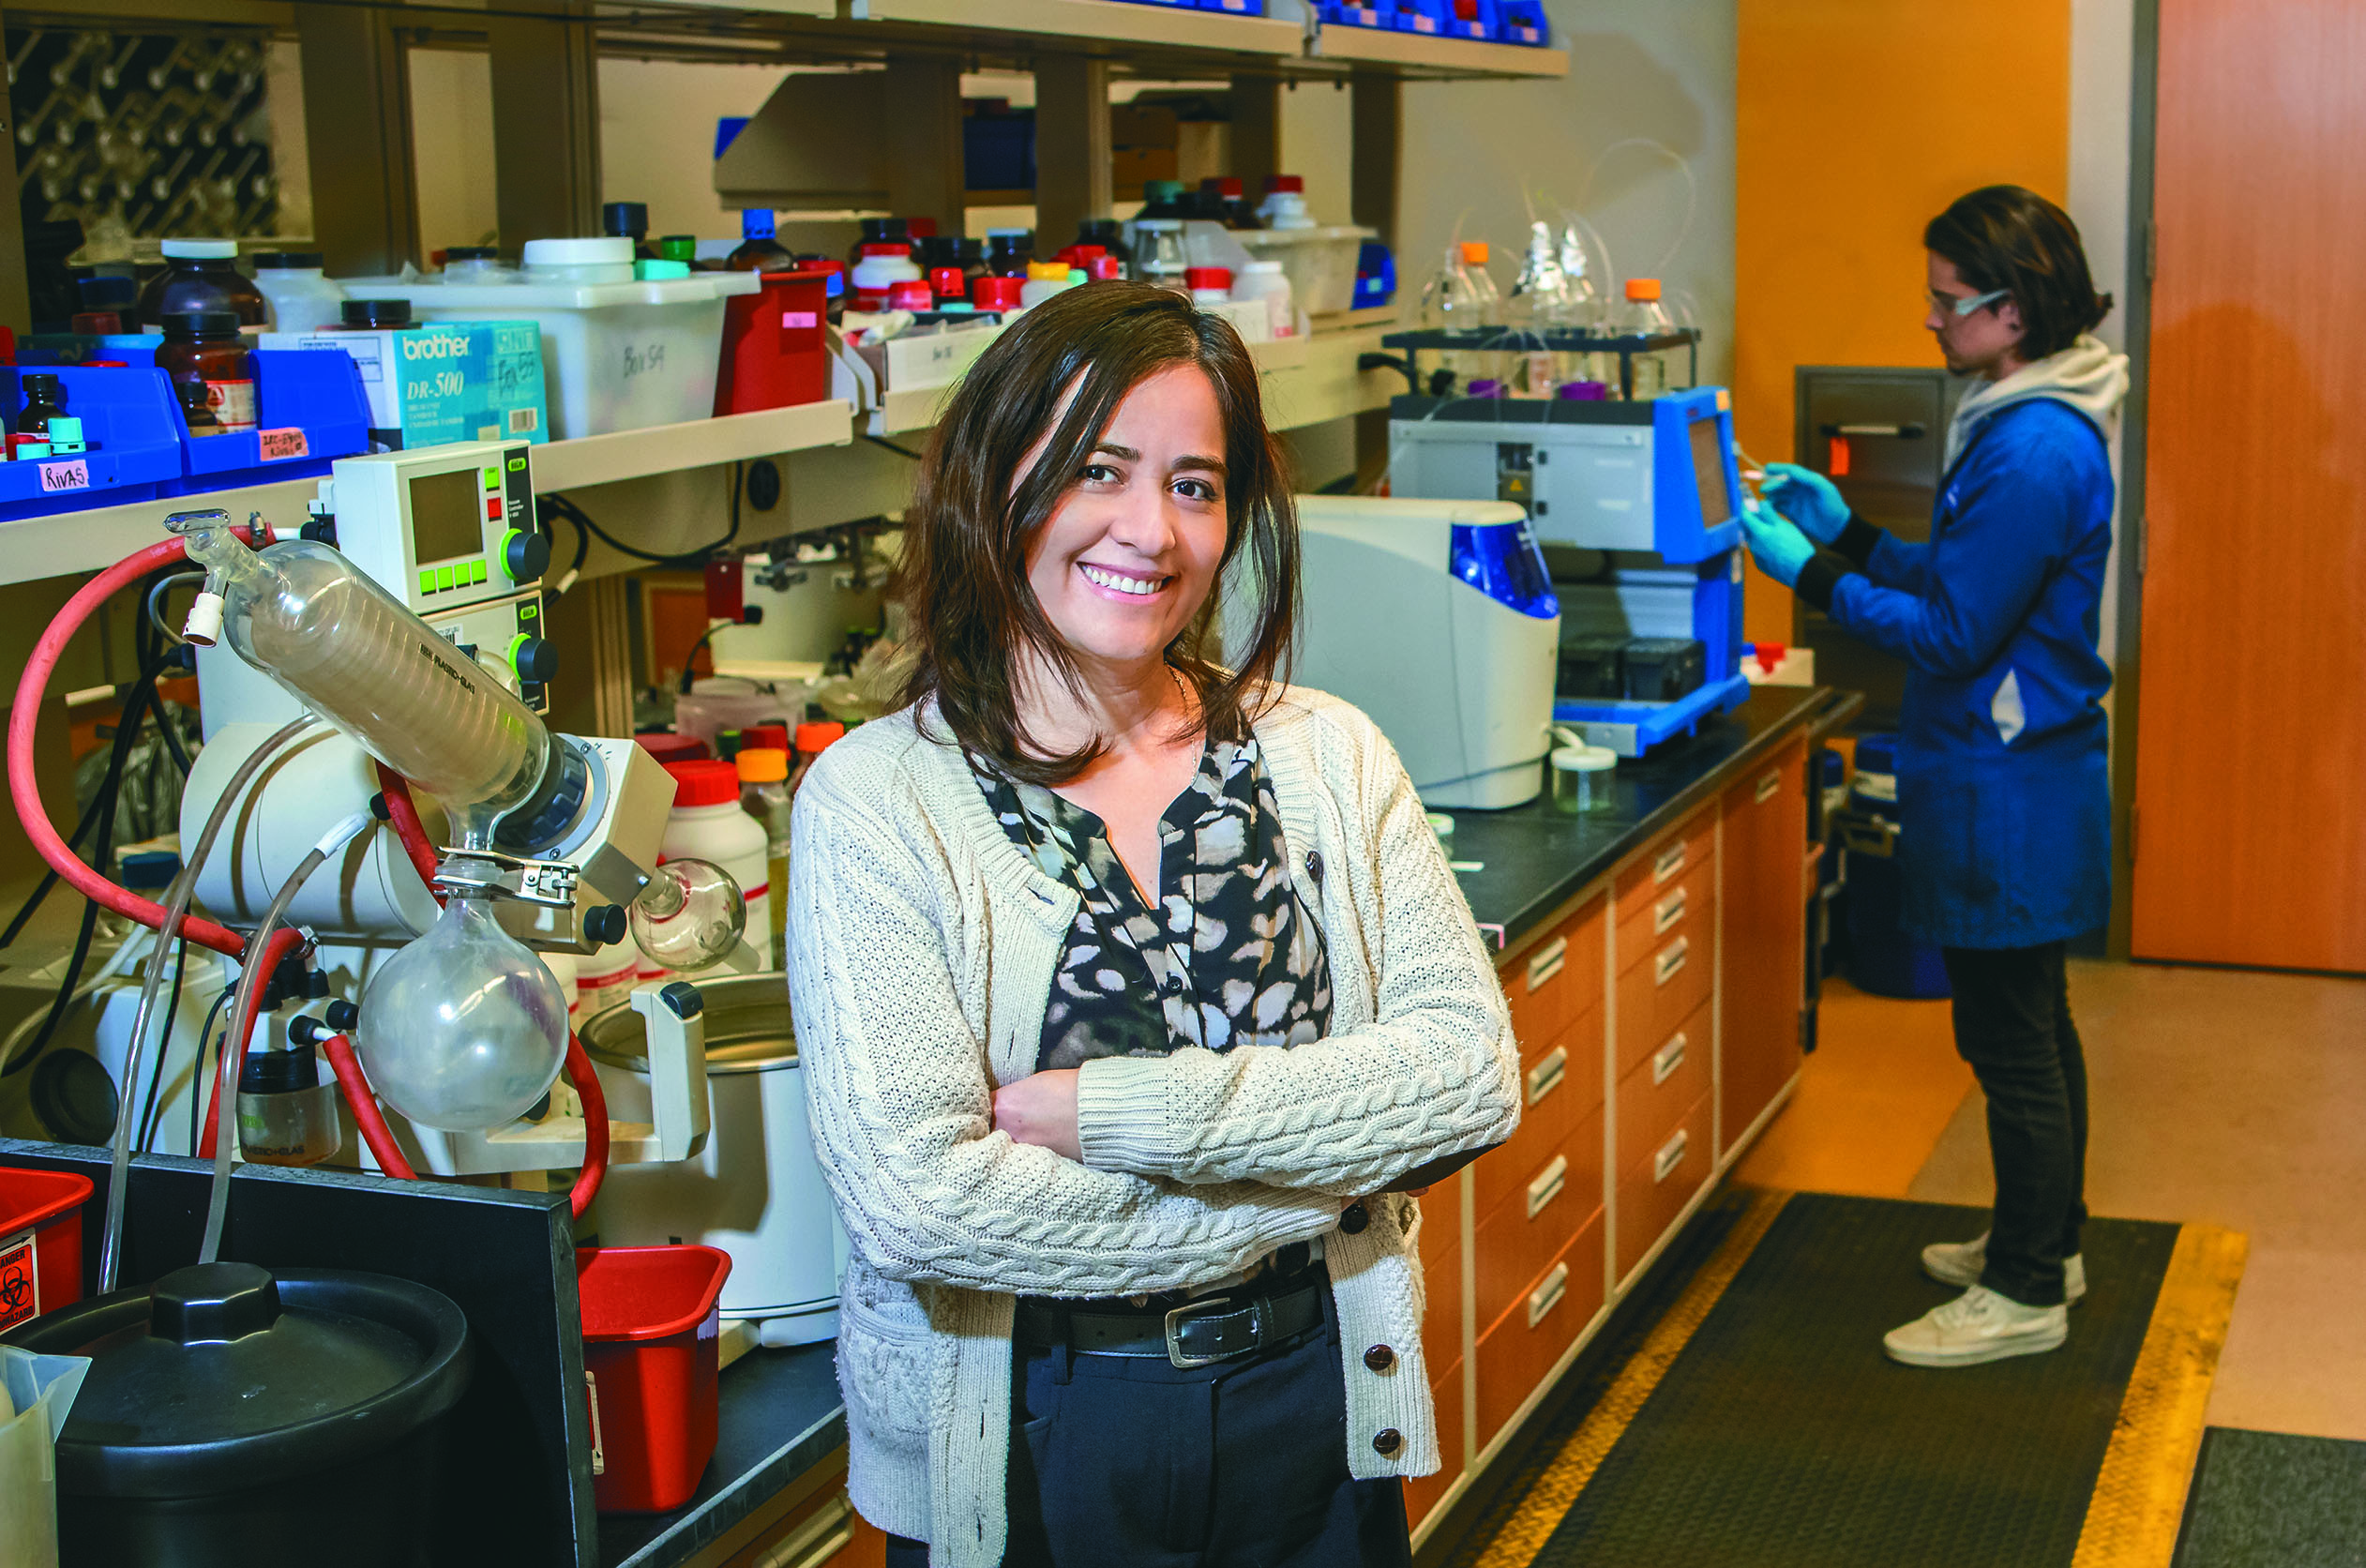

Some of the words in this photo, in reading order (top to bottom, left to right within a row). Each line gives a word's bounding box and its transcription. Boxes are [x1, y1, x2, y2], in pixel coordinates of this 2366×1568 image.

[403, 334, 471, 361] brother
[407, 371, 464, 400] DR-500
[0, 1249, 25, 1269] ANGER
